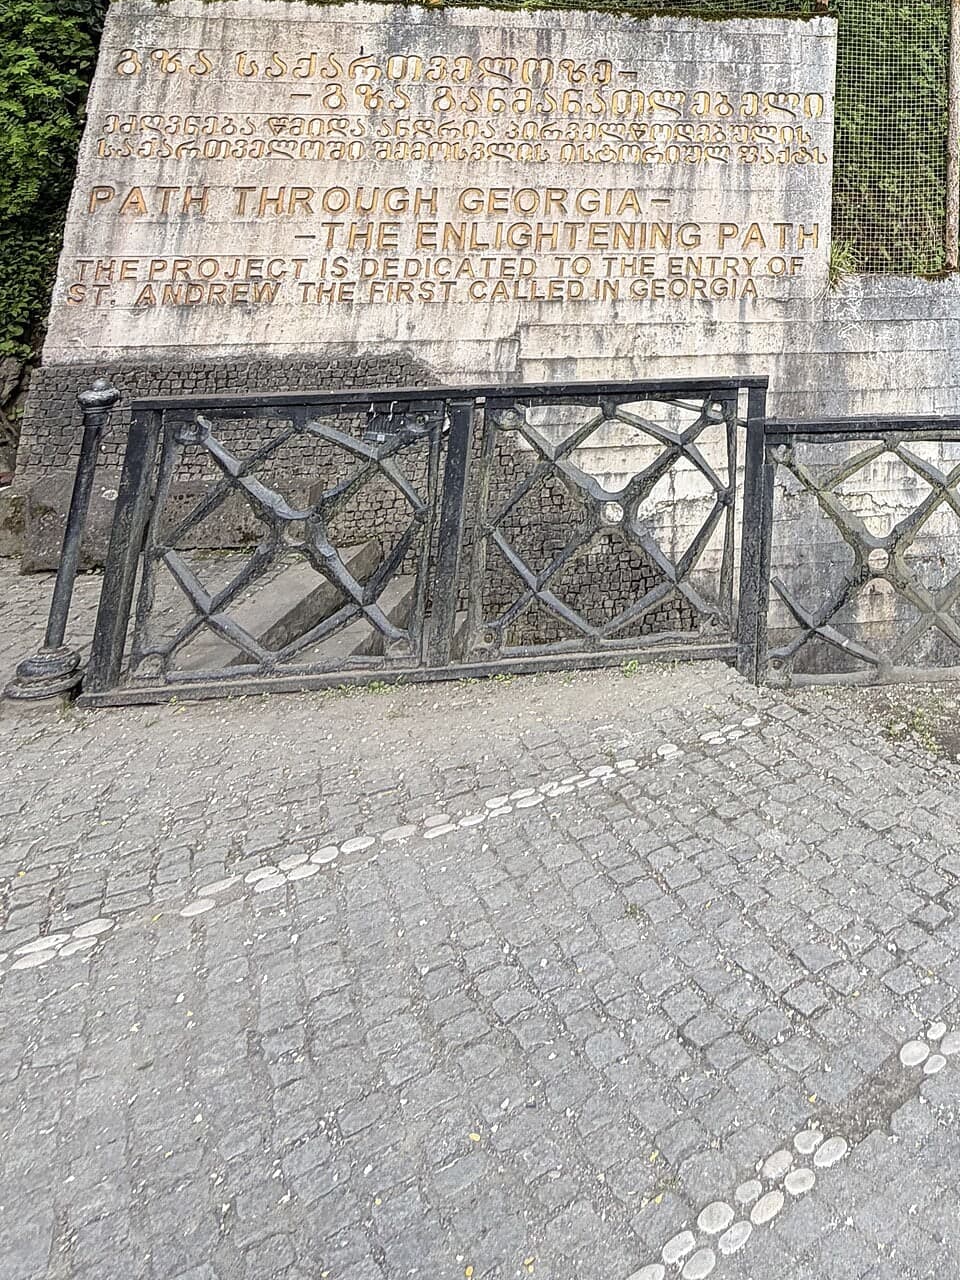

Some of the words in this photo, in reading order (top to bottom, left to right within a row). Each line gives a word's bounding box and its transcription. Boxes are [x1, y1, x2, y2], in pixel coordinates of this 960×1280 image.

[88, 185, 211, 216] PATH
[233, 186, 438, 217] THROUGH
[415, 222, 701, 251] ENLIGHTENING
[718, 222, 819, 250] PATH
[76, 258, 140, 281] THE
[150, 258, 309, 281] PROJECT
[320, 256, 348, 279] IS
[360, 257, 538, 279] DEDICATED
[555, 256, 592, 276] TO
[602, 256, 656, 277] THE
[668, 256, 758, 277] ENTRY
[767, 256, 805, 276] OF
[66, 283, 117, 306] ST.
[134, 281, 282, 305] ANDREW
[298, 281, 356, 304] THE
[369, 280, 457, 303] FIRST
[468, 279, 585, 303] CALLED
[594, 279, 620, 300] IN
[630, 277, 759, 299] GEORGIA
